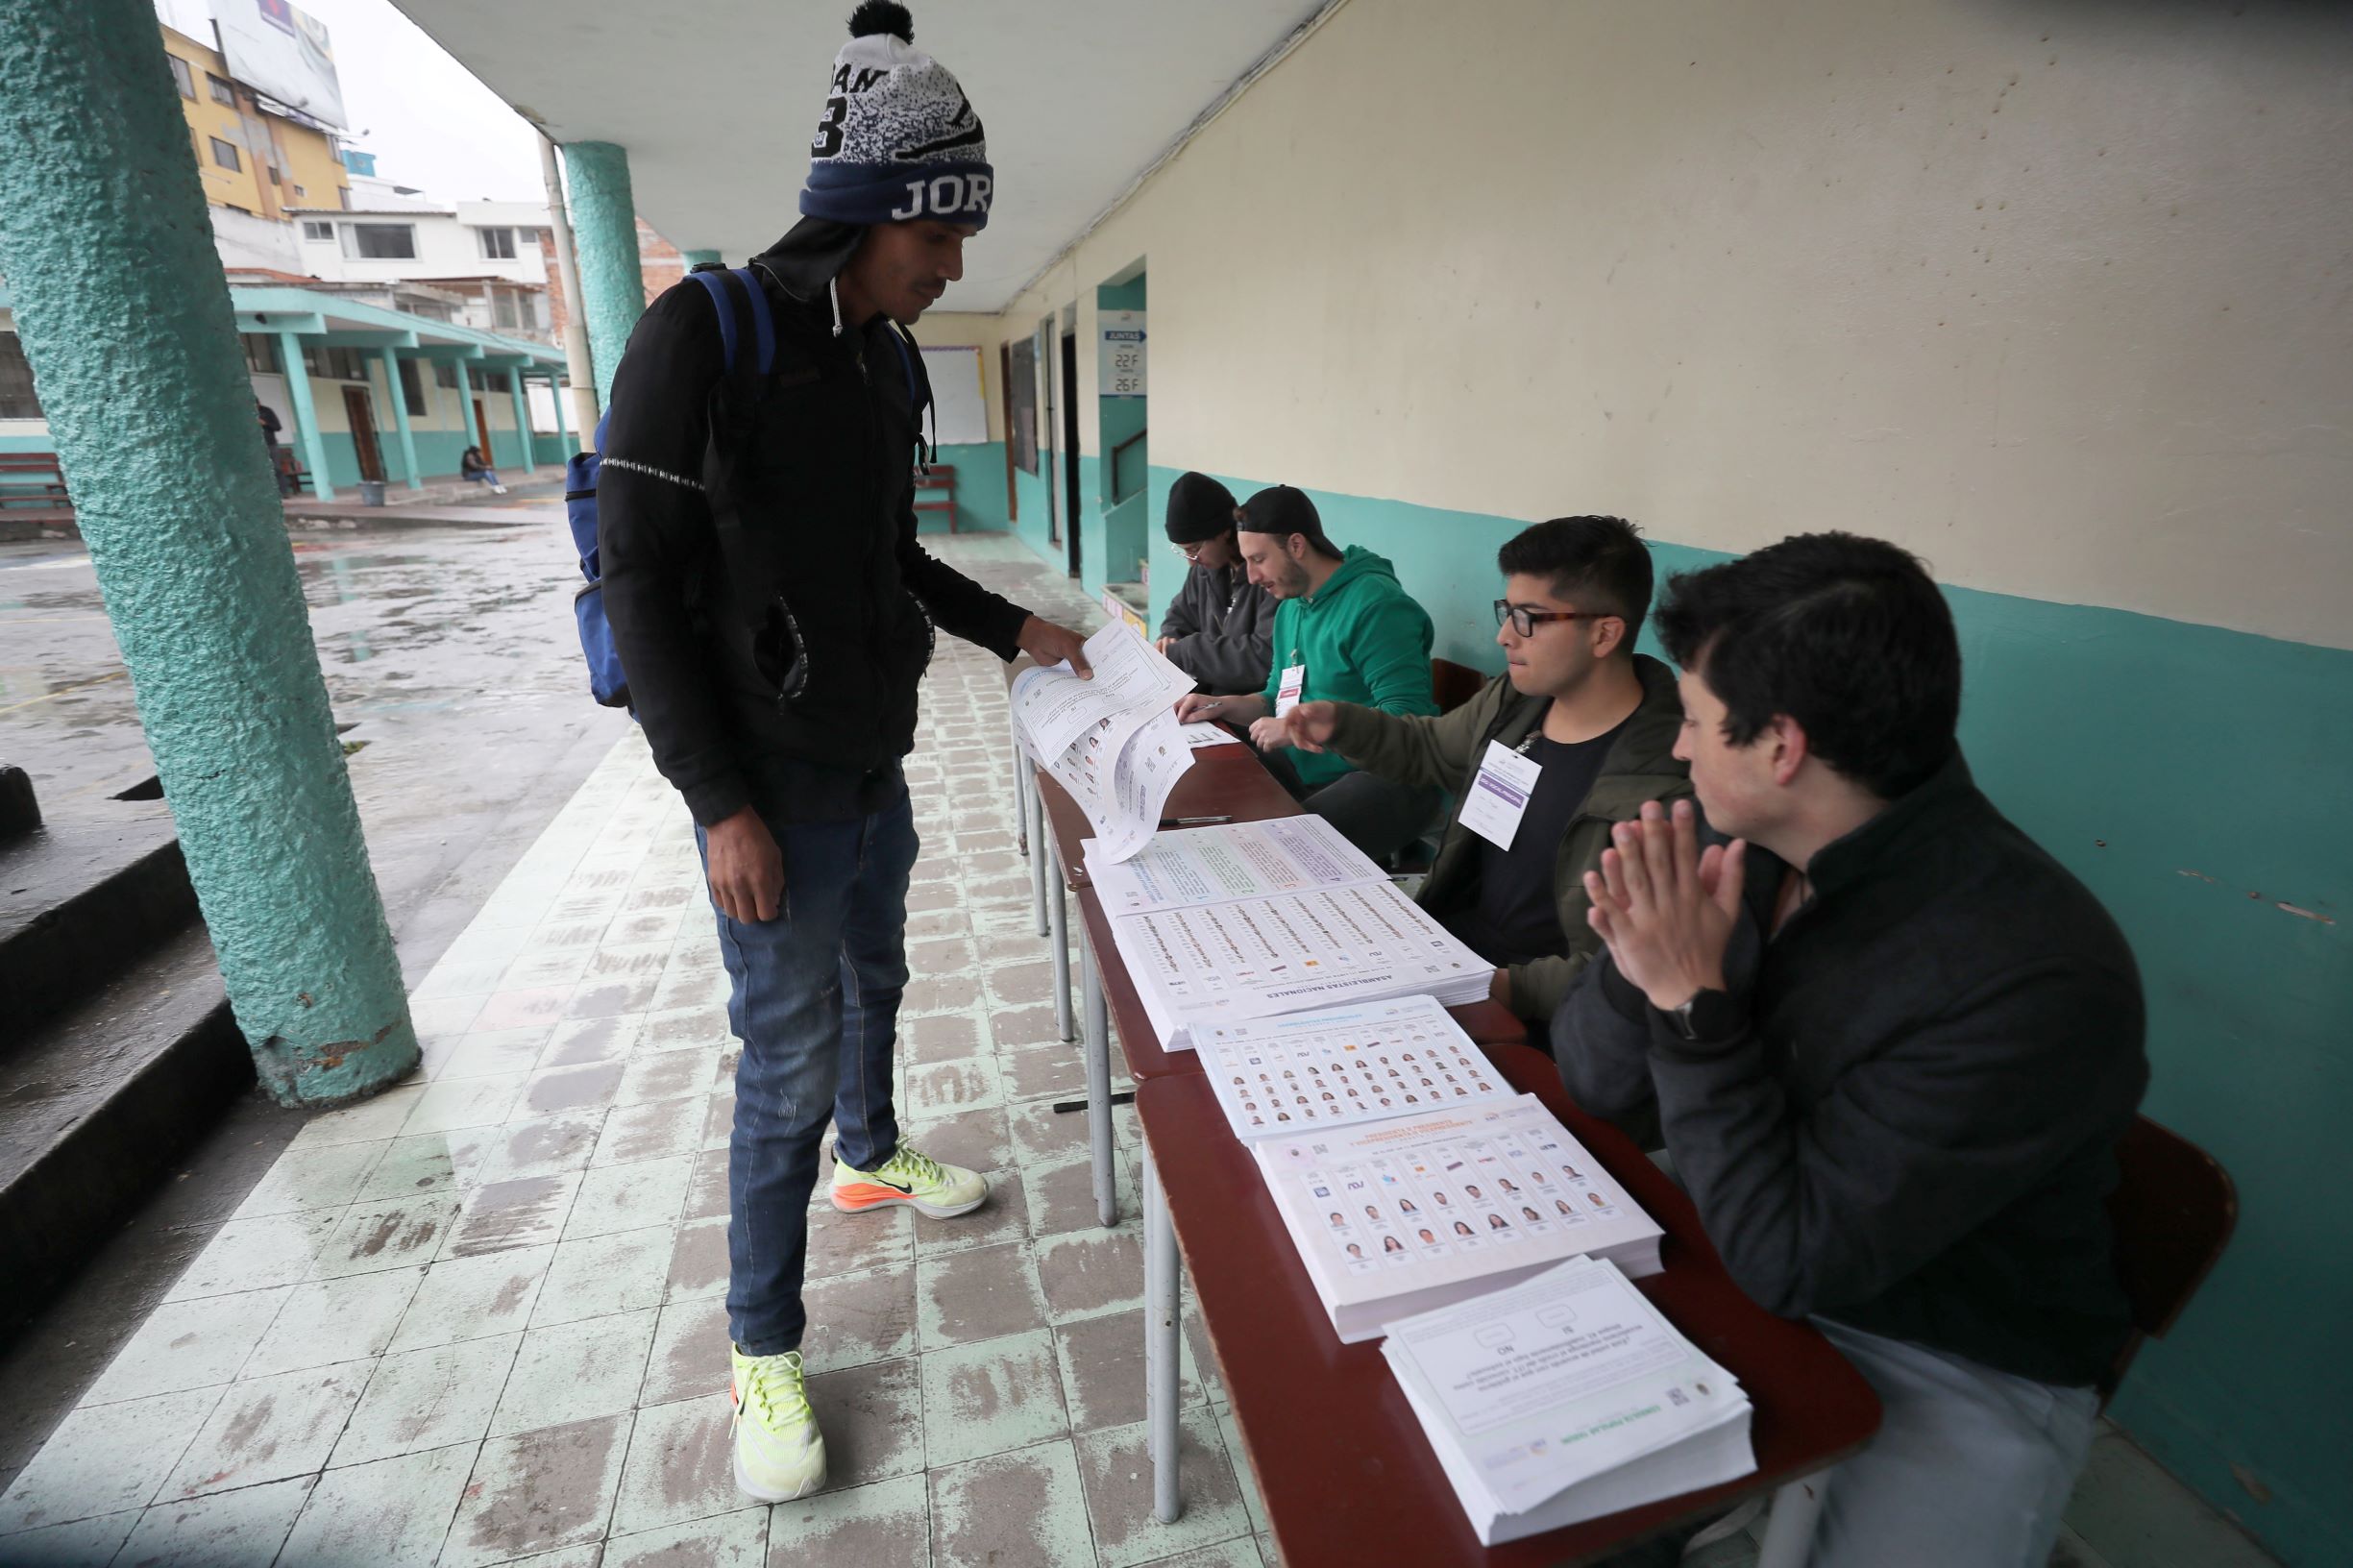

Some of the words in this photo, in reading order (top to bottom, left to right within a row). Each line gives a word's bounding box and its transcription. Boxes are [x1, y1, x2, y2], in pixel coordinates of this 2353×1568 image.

[830, 63, 889, 94] AN
[892, 173, 992, 220] JOR
[1266, 984, 1324, 998] NACIONALES
[1497, 1345, 1514, 1355] NO
